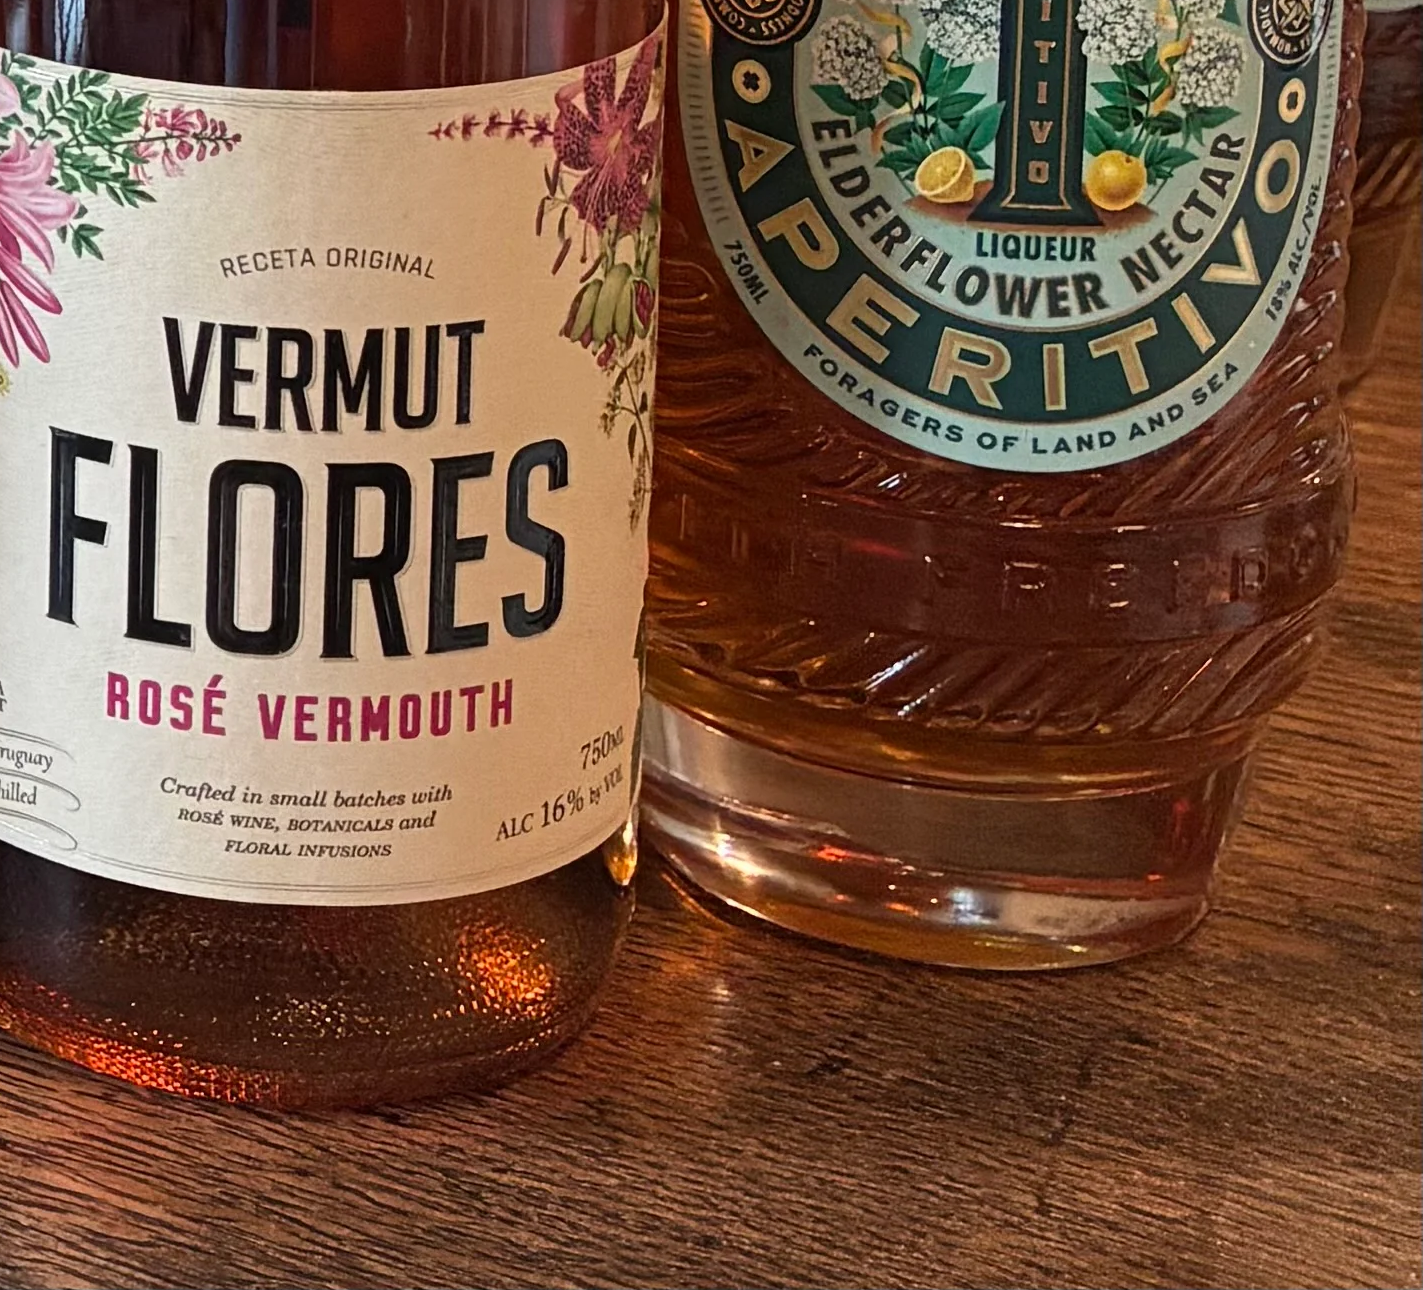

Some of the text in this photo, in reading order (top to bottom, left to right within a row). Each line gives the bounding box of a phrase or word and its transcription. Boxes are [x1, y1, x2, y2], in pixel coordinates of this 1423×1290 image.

[810, 118, 1247, 319] ELDERFLOWER NECTAR
[975, 230, 1098, 264] LIQUEUR
[220, 248, 436, 280] RECETA ORIGINAL
[723, 239, 770, 306] 750ML
[724, 119, 1300, 412] APERITIVO
[162, 317, 486, 433] VERMUT
[803, 342, 1239, 455] FORAGERS OF LAND AND SEA
[46, 425, 570, 661] FLORES
[106, 671, 514, 743] ROSÉ VERMOUTH
[160, 776, 453, 809] Crafted in small batches with
[178, 808, 437, 833] ROSÉ WINE, BOTANICALS and
[495, 813, 535, 842] ALC
[540, 785, 585, 829] 16%
[224, 839, 393, 859] FLORAL INFUSIONS
